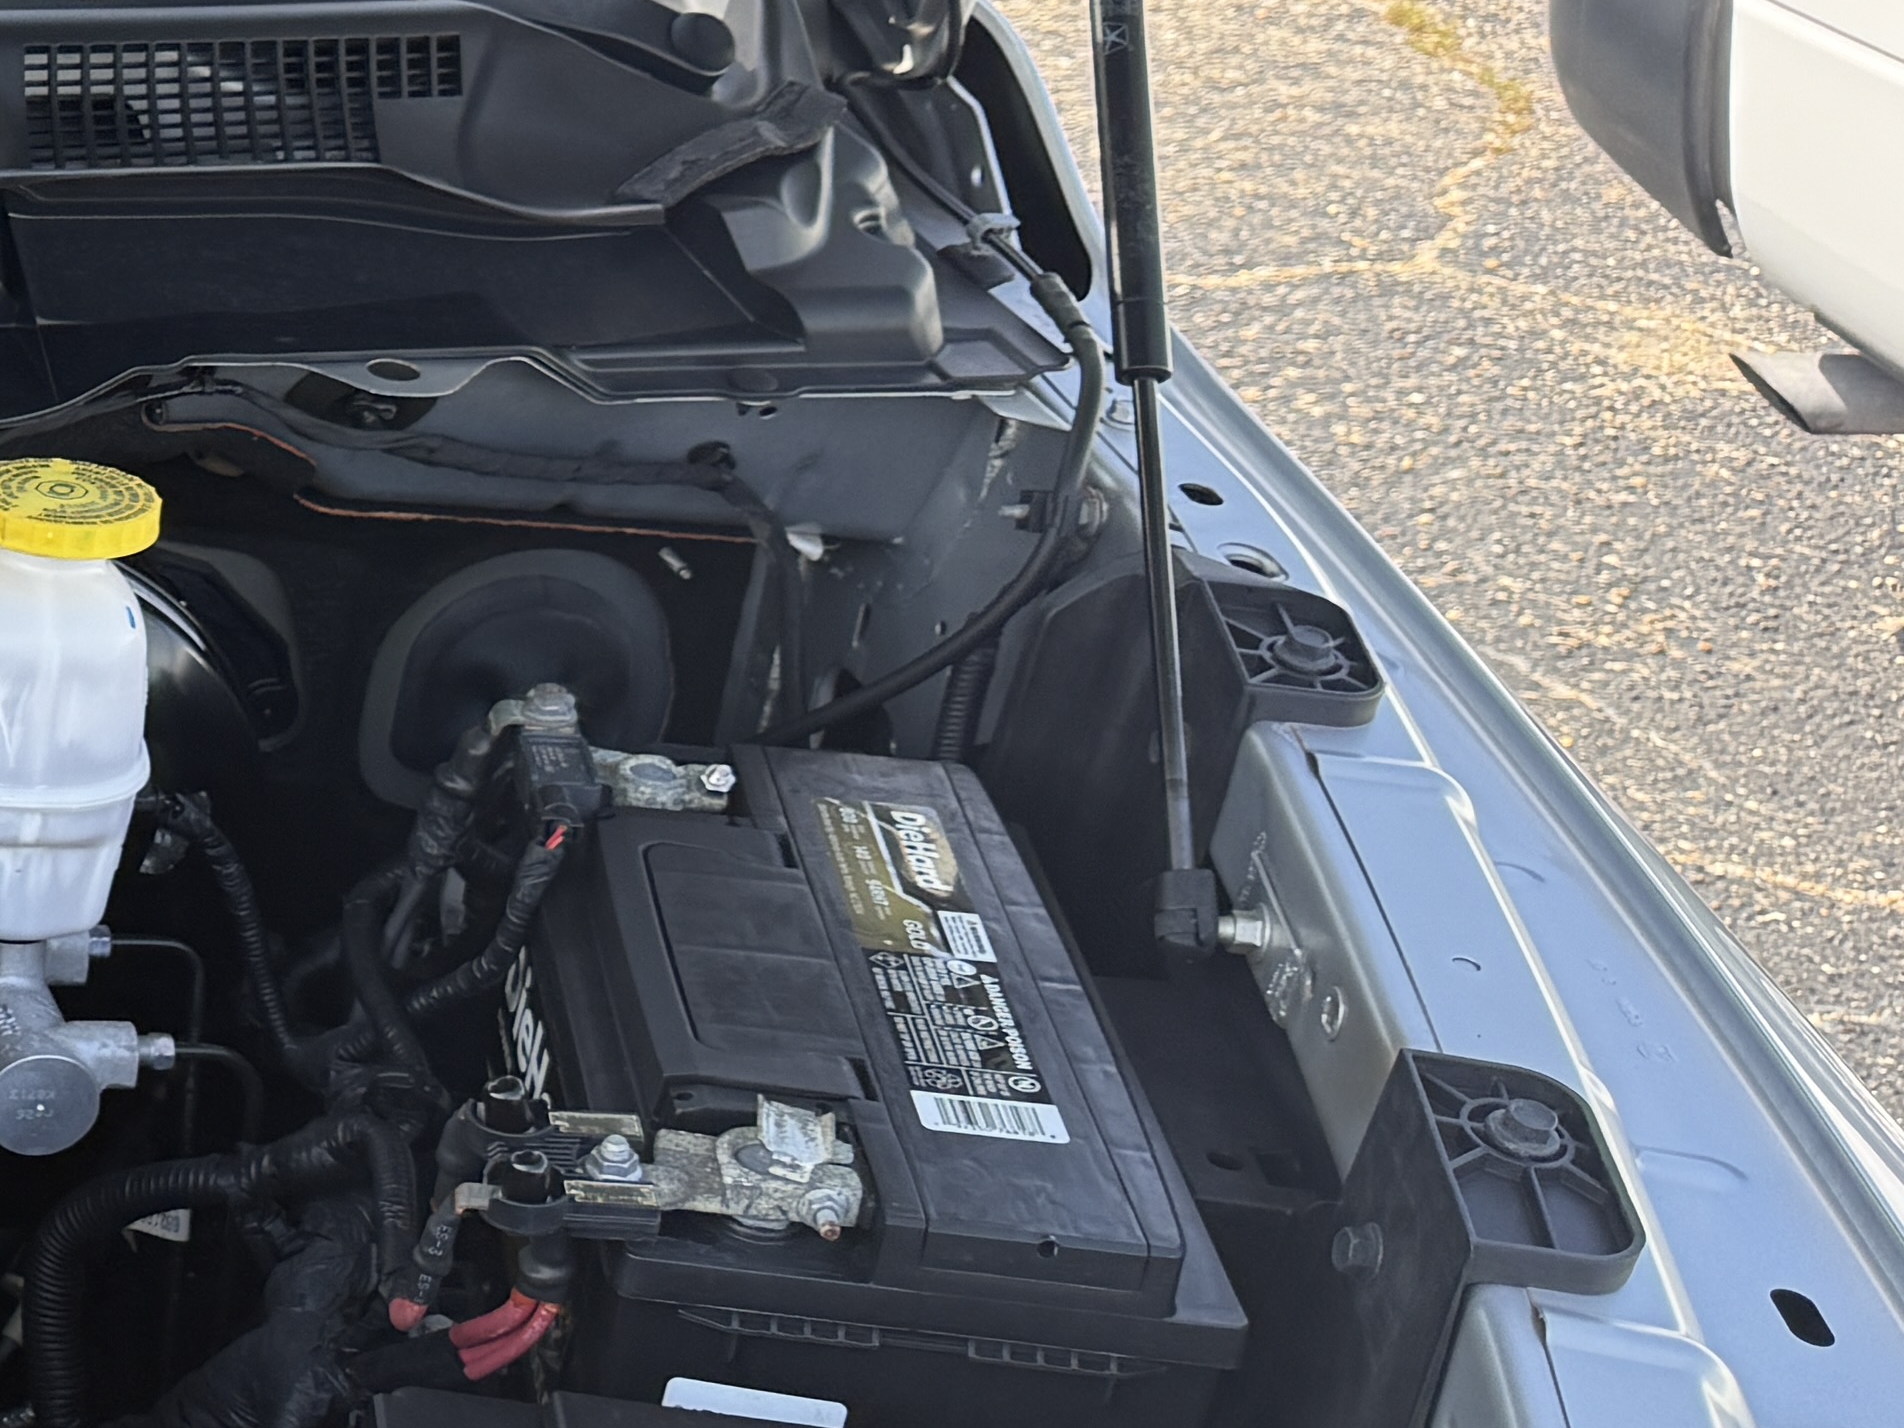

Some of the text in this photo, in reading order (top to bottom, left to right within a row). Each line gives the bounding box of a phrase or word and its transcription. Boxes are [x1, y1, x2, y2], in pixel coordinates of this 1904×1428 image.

[890, 811, 953, 892] DieHard
[902, 919, 931, 950] GOLD
[505, 946, 550, 1109] DieH
